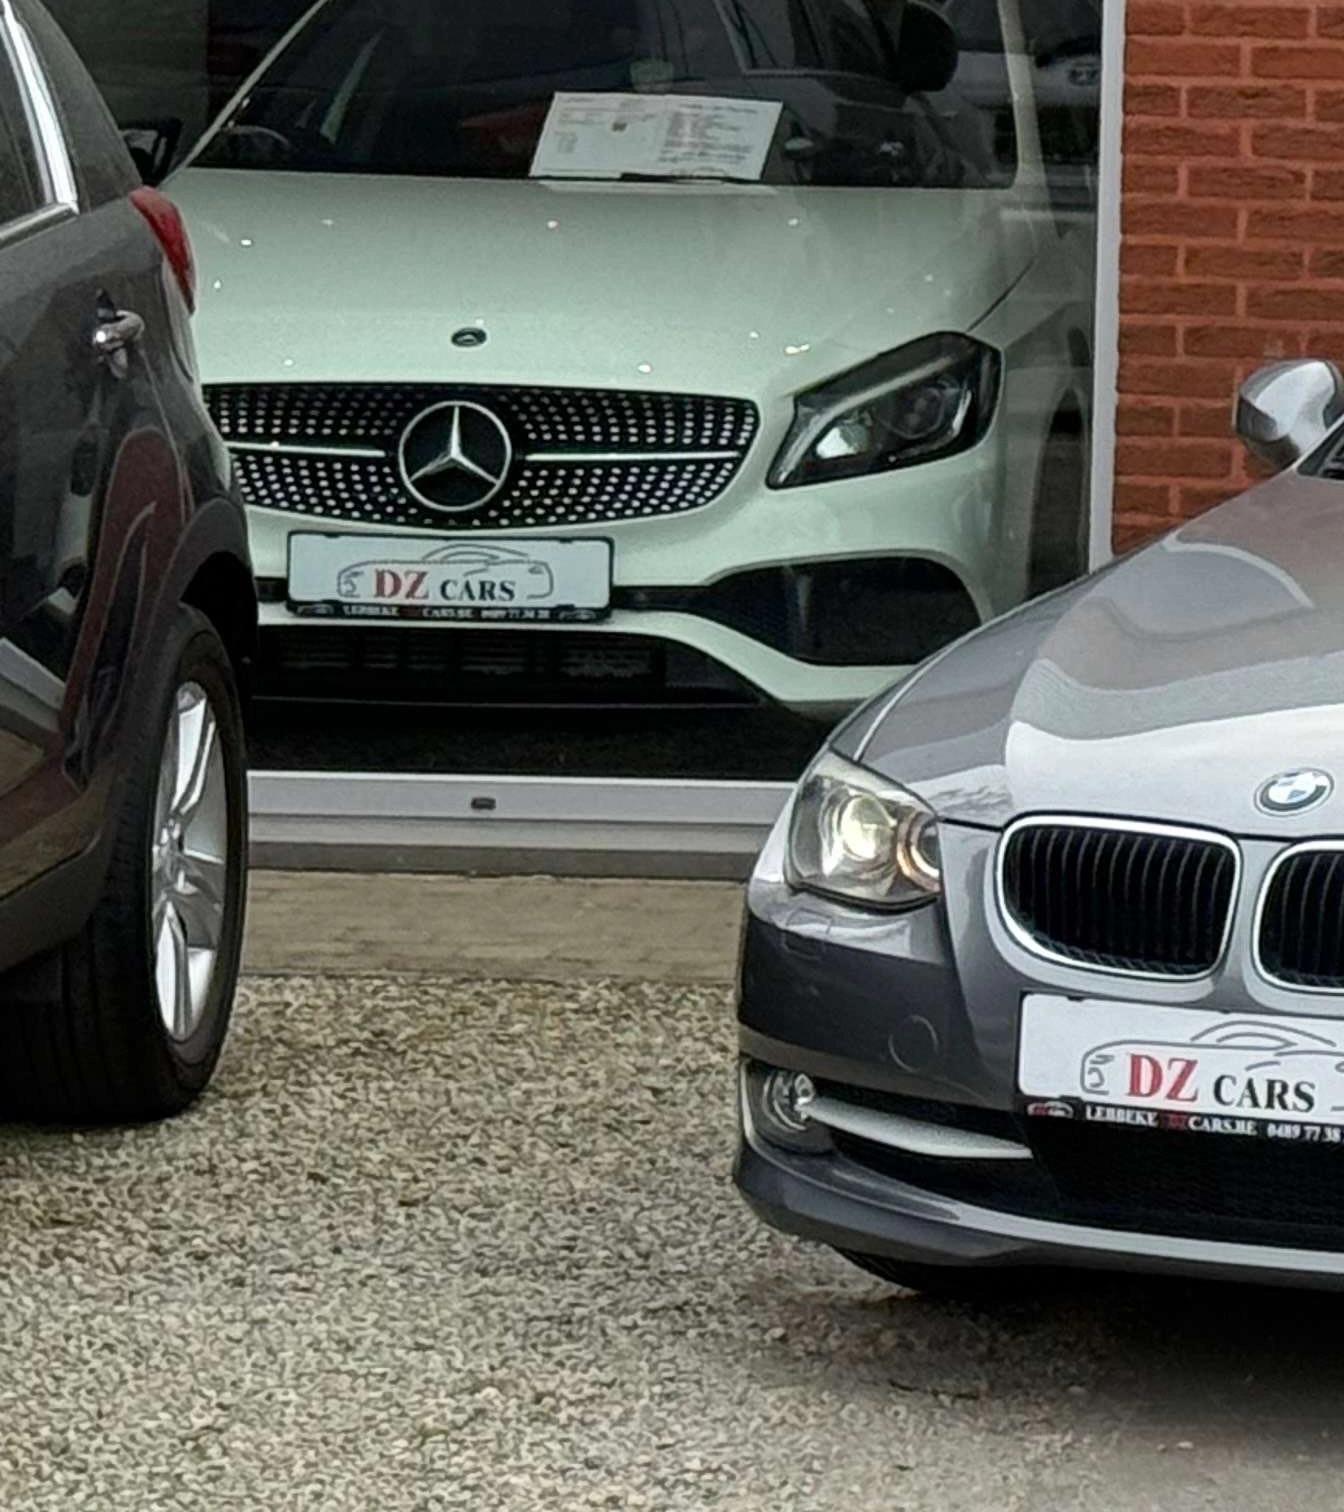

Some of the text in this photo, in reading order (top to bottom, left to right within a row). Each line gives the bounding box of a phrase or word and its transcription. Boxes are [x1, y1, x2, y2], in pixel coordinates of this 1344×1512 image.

[373, 568, 516, 602] DZ CARS
[1126, 1052, 1316, 1113] DZ CARS
